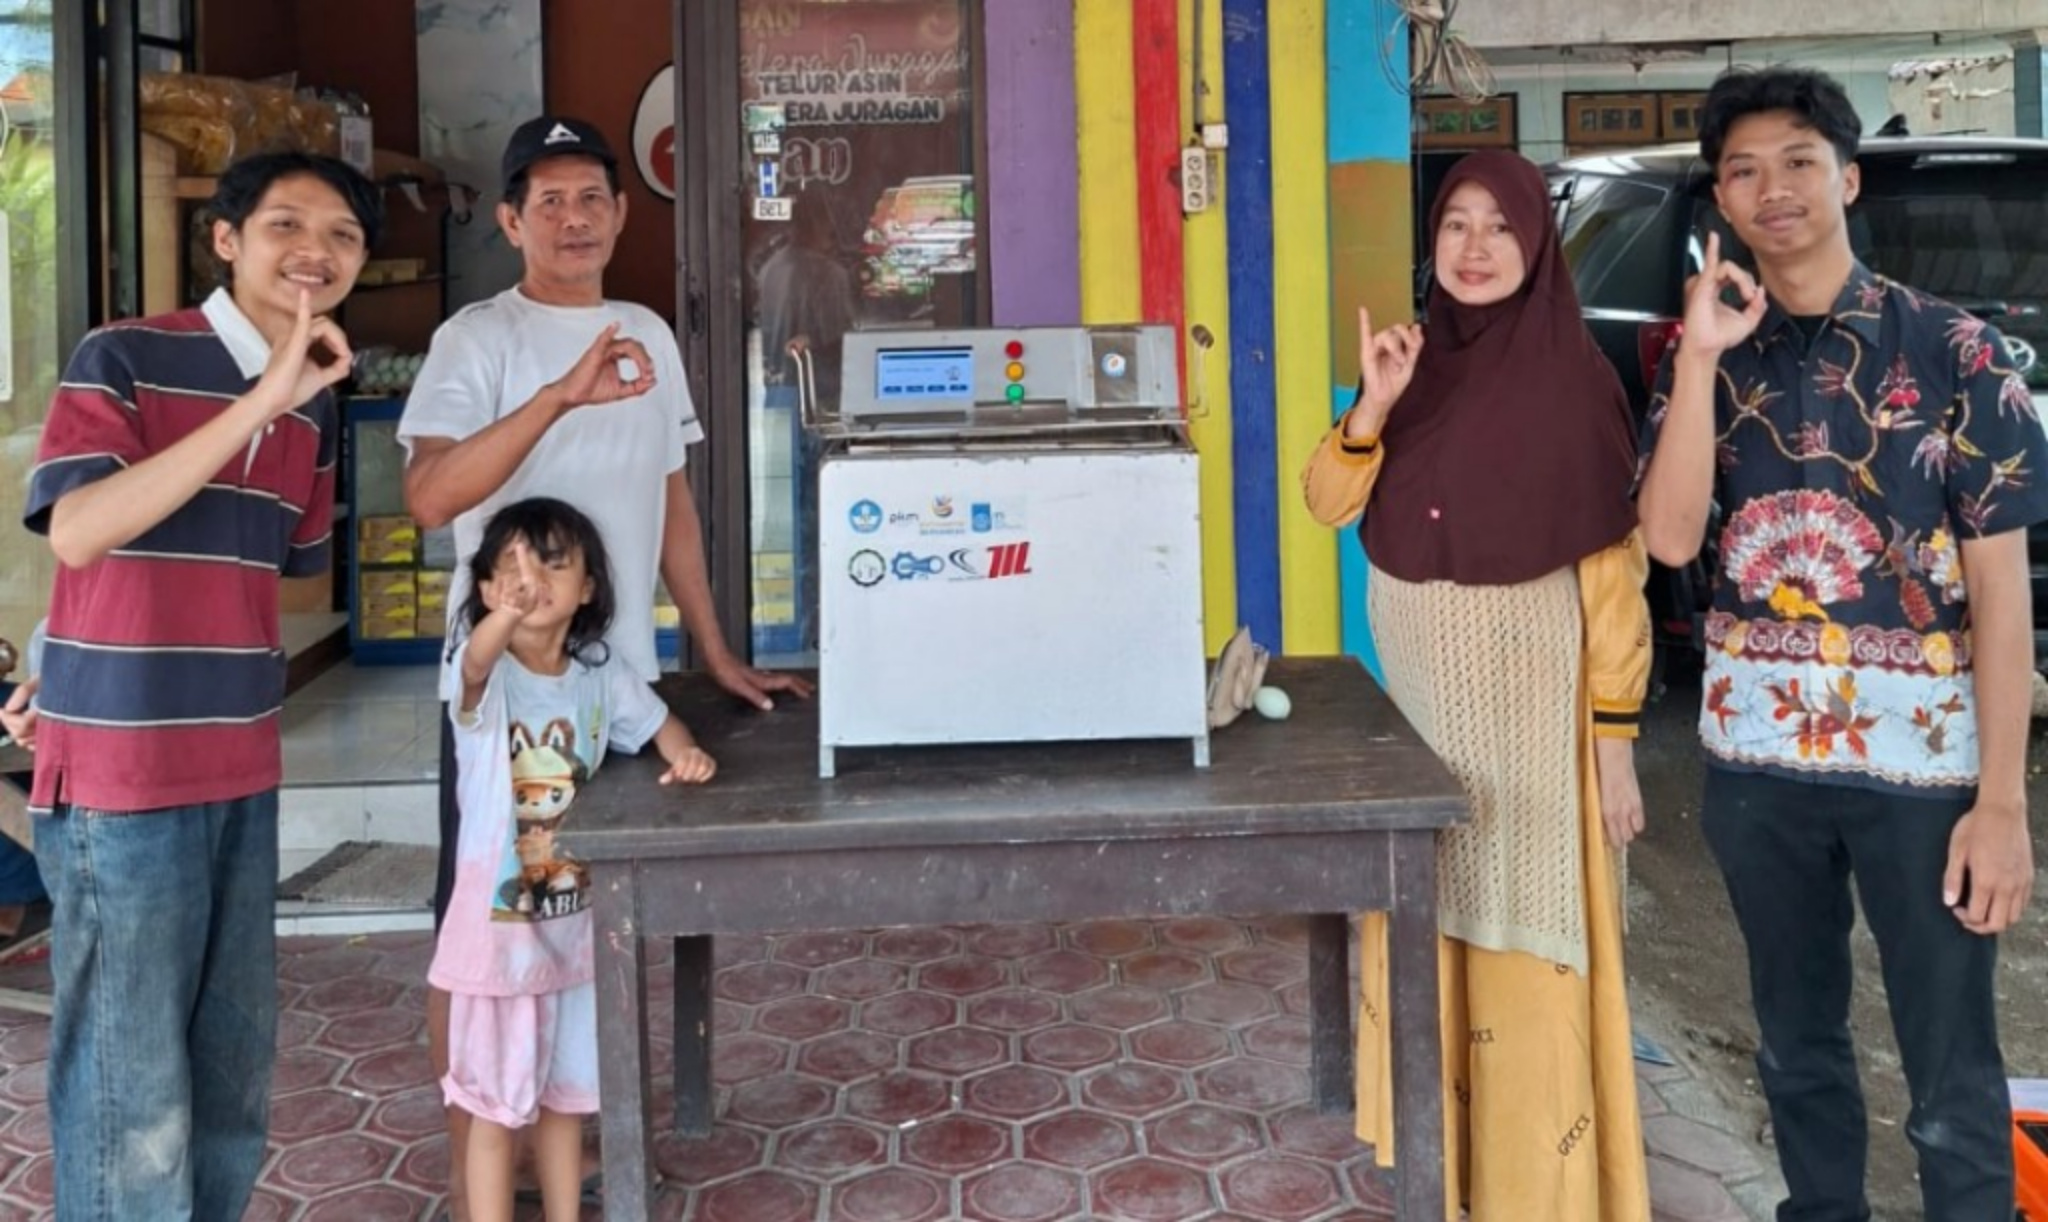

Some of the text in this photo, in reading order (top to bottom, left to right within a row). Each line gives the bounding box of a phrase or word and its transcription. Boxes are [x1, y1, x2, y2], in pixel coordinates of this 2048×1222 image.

[759, 72, 902, 95] TELUR ASIN
[834, 99, 940, 122] JURAGAN
[1557, 1113, 1592, 1157] GUCCI
